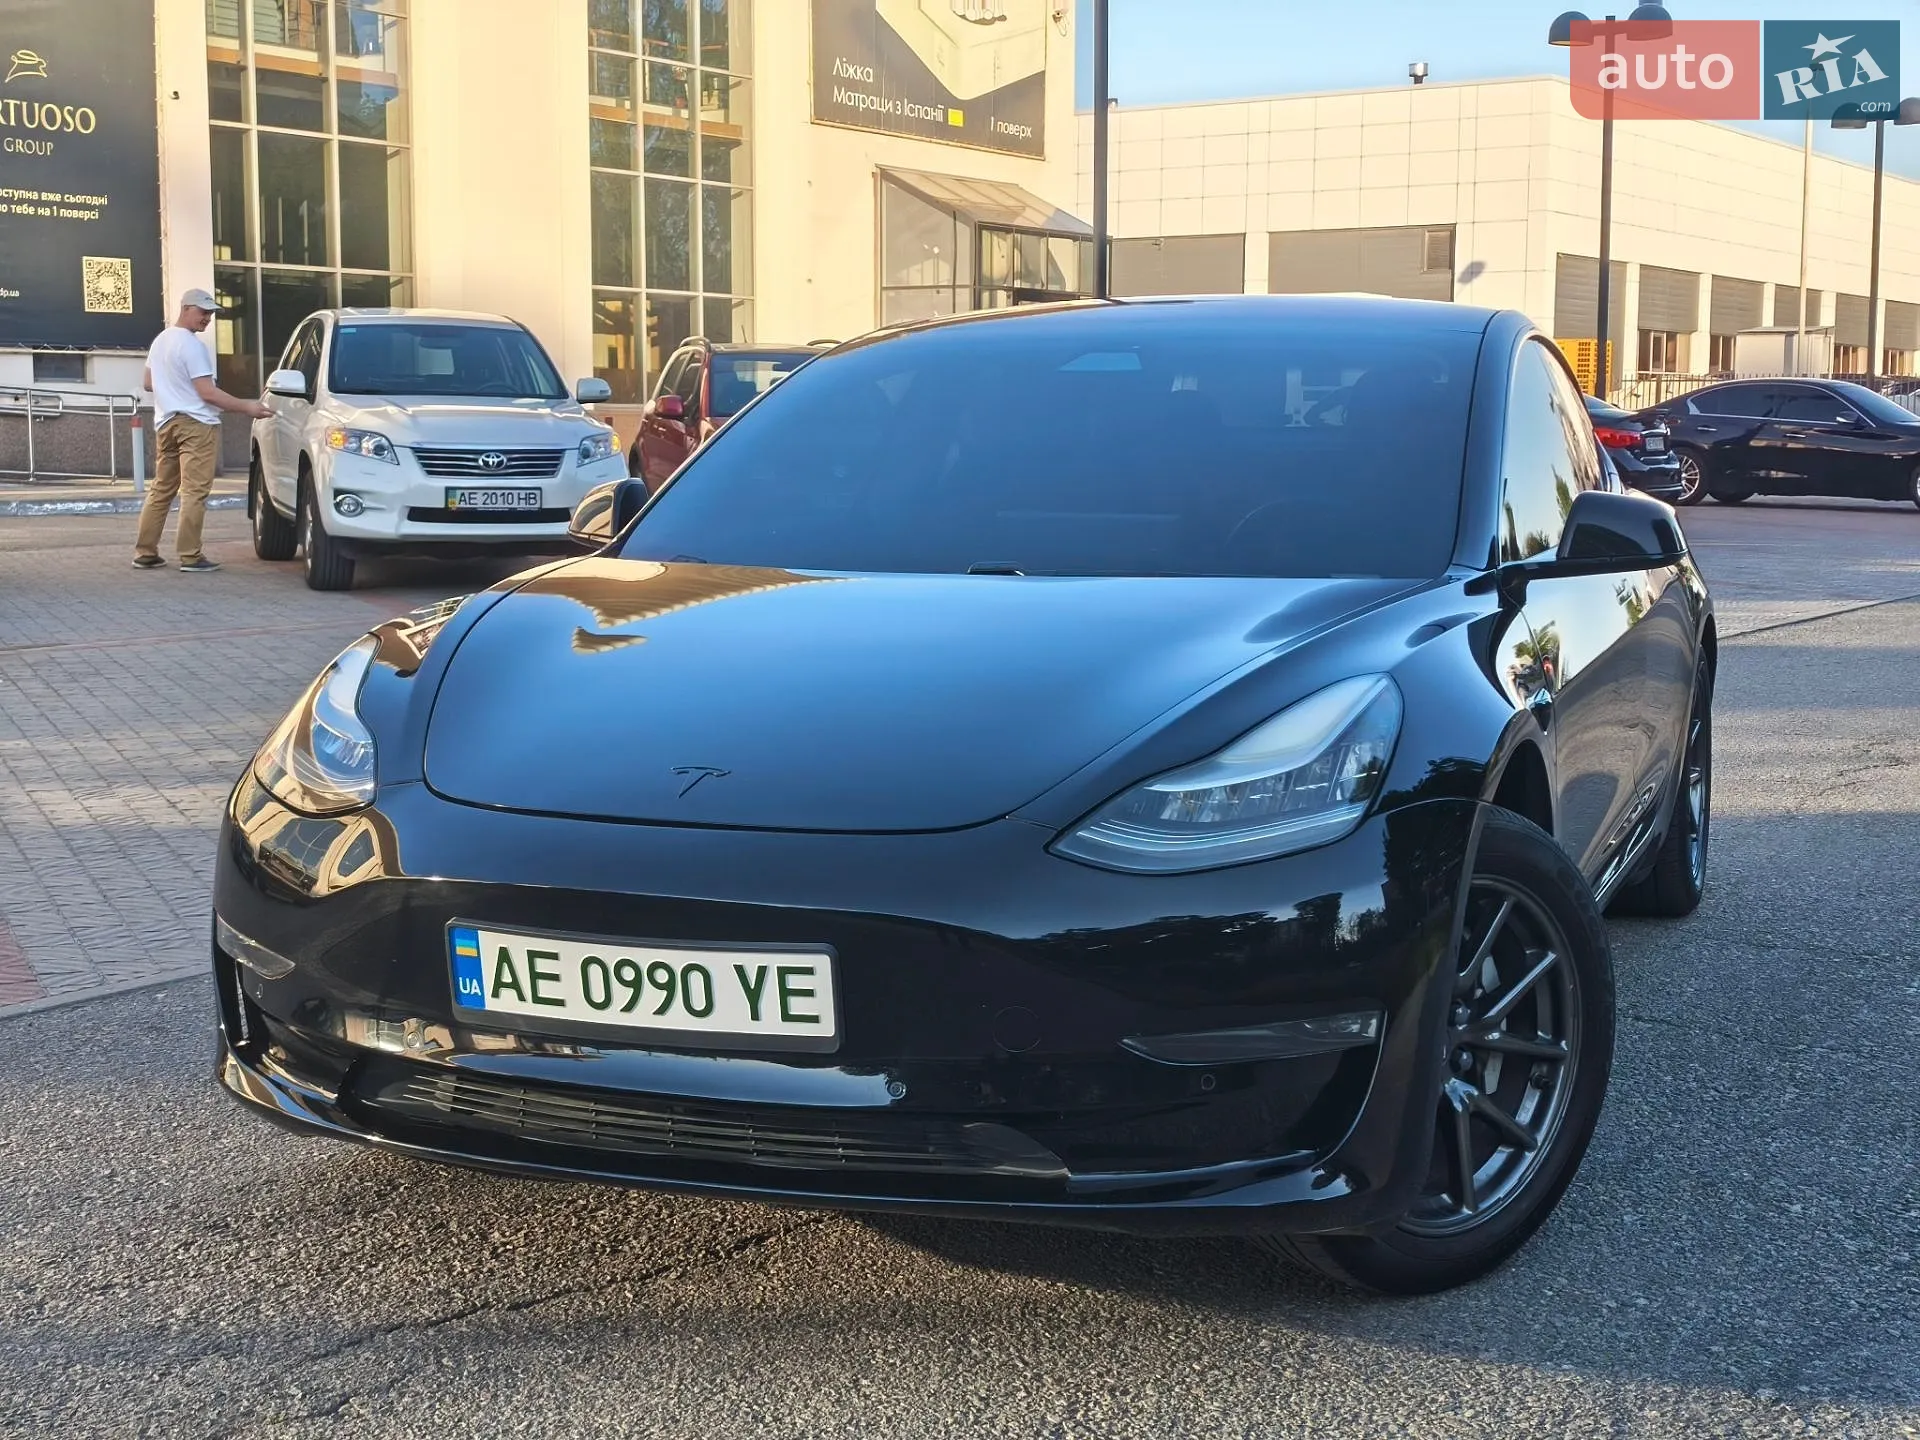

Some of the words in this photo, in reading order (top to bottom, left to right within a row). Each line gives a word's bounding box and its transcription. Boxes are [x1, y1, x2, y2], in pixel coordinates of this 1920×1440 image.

[832, 57, 874, 83] Ліжка
[833, 85, 893, 114] Матраци
[895, 101, 902, 115] з
[904, 98, 945, 122] Іспанії
[997, 121, 1033, 140] поверх
[3, 137, 54, 156] GROUP
[0, 187, 39, 201] ступна
[41, 191, 62, 202] вже
[64, 194, 108, 206] сьогодні
[10, 203, 35, 215] тебе
[37, 206, 50, 217] на
[52, 205, 57, 217] 1
[59, 208, 100, 221] поверсі
[458, 491, 479, 506] AE
[482, 491, 515, 506] 2010
[517, 491, 538, 506] HB
[458, 976, 482, 997] UA
[490, 945, 567, 1008] AE
[579, 954, 714, 1019] 0990
[732, 963, 822, 1024] YE
